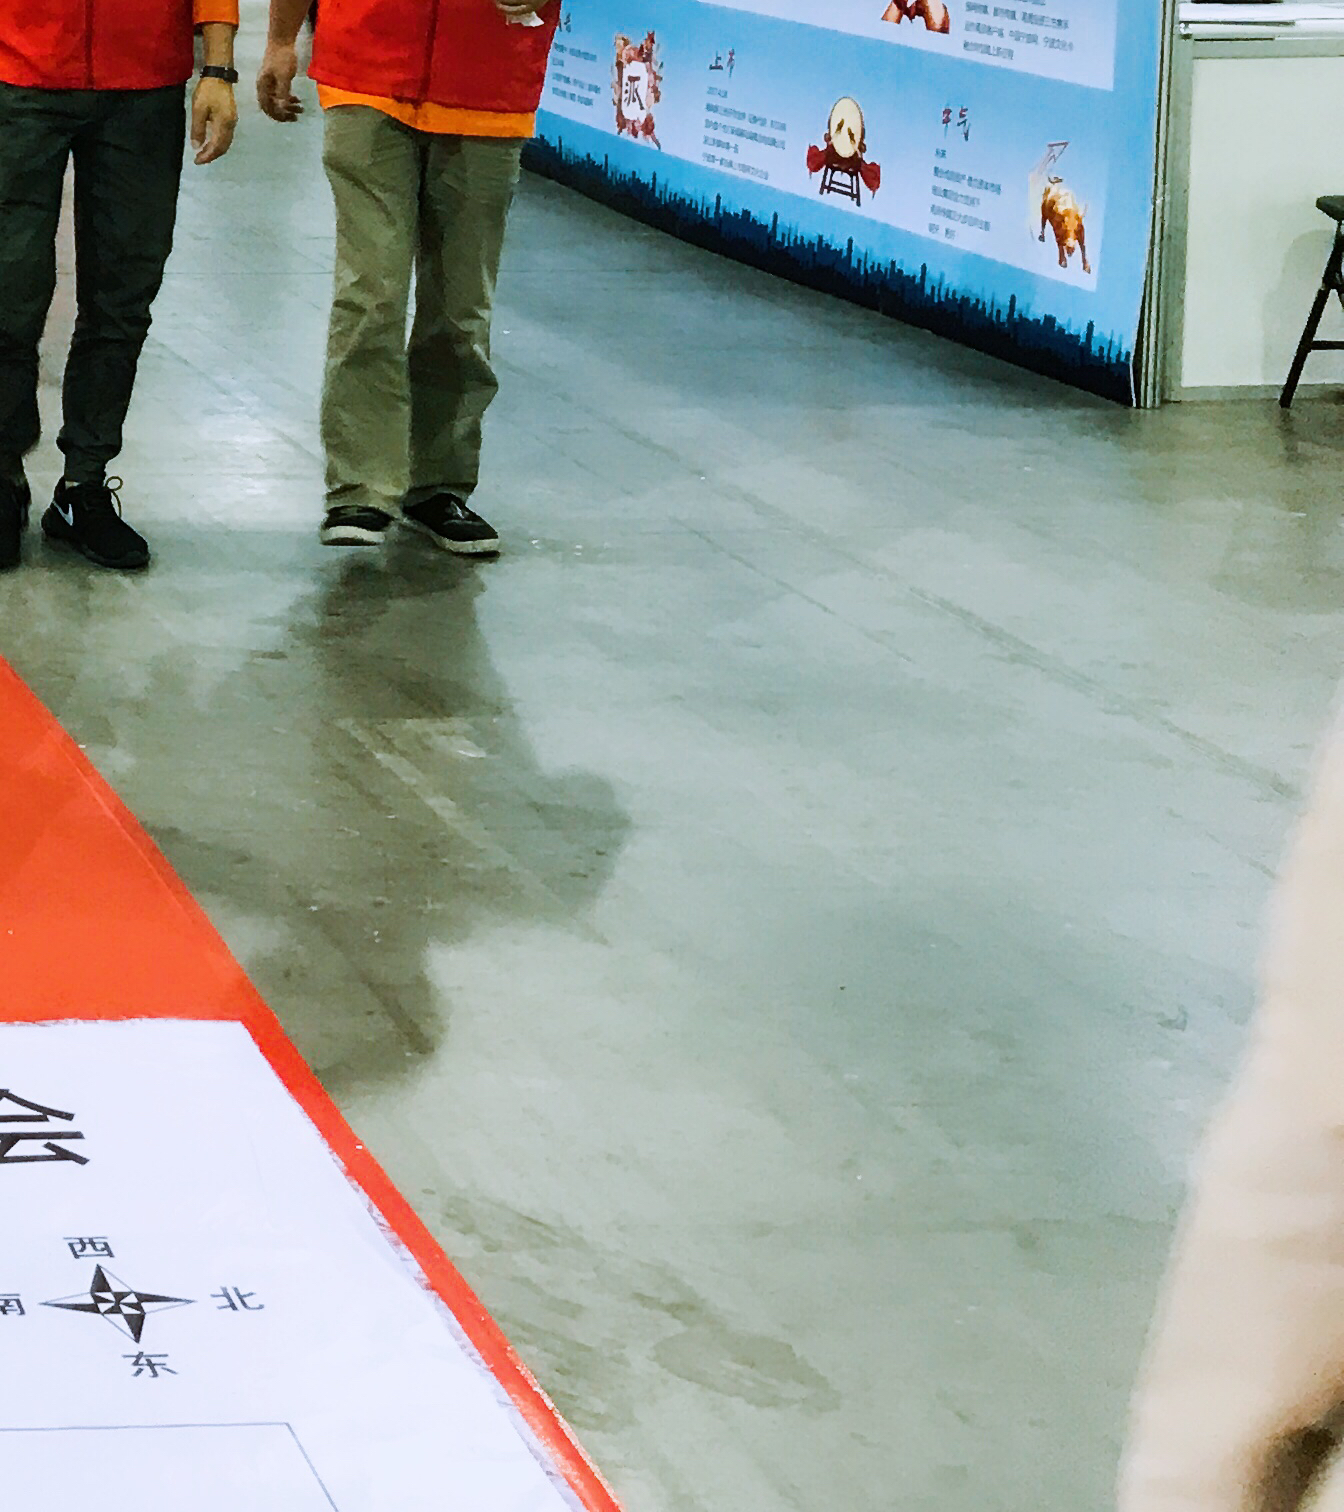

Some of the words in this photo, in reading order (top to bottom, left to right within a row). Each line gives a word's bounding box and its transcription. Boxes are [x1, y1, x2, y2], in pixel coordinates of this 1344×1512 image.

[63, 1235, 116, 1260] 西
[210, 1286, 265, 1312] 北
[121, 1351, 179, 1379] 东
